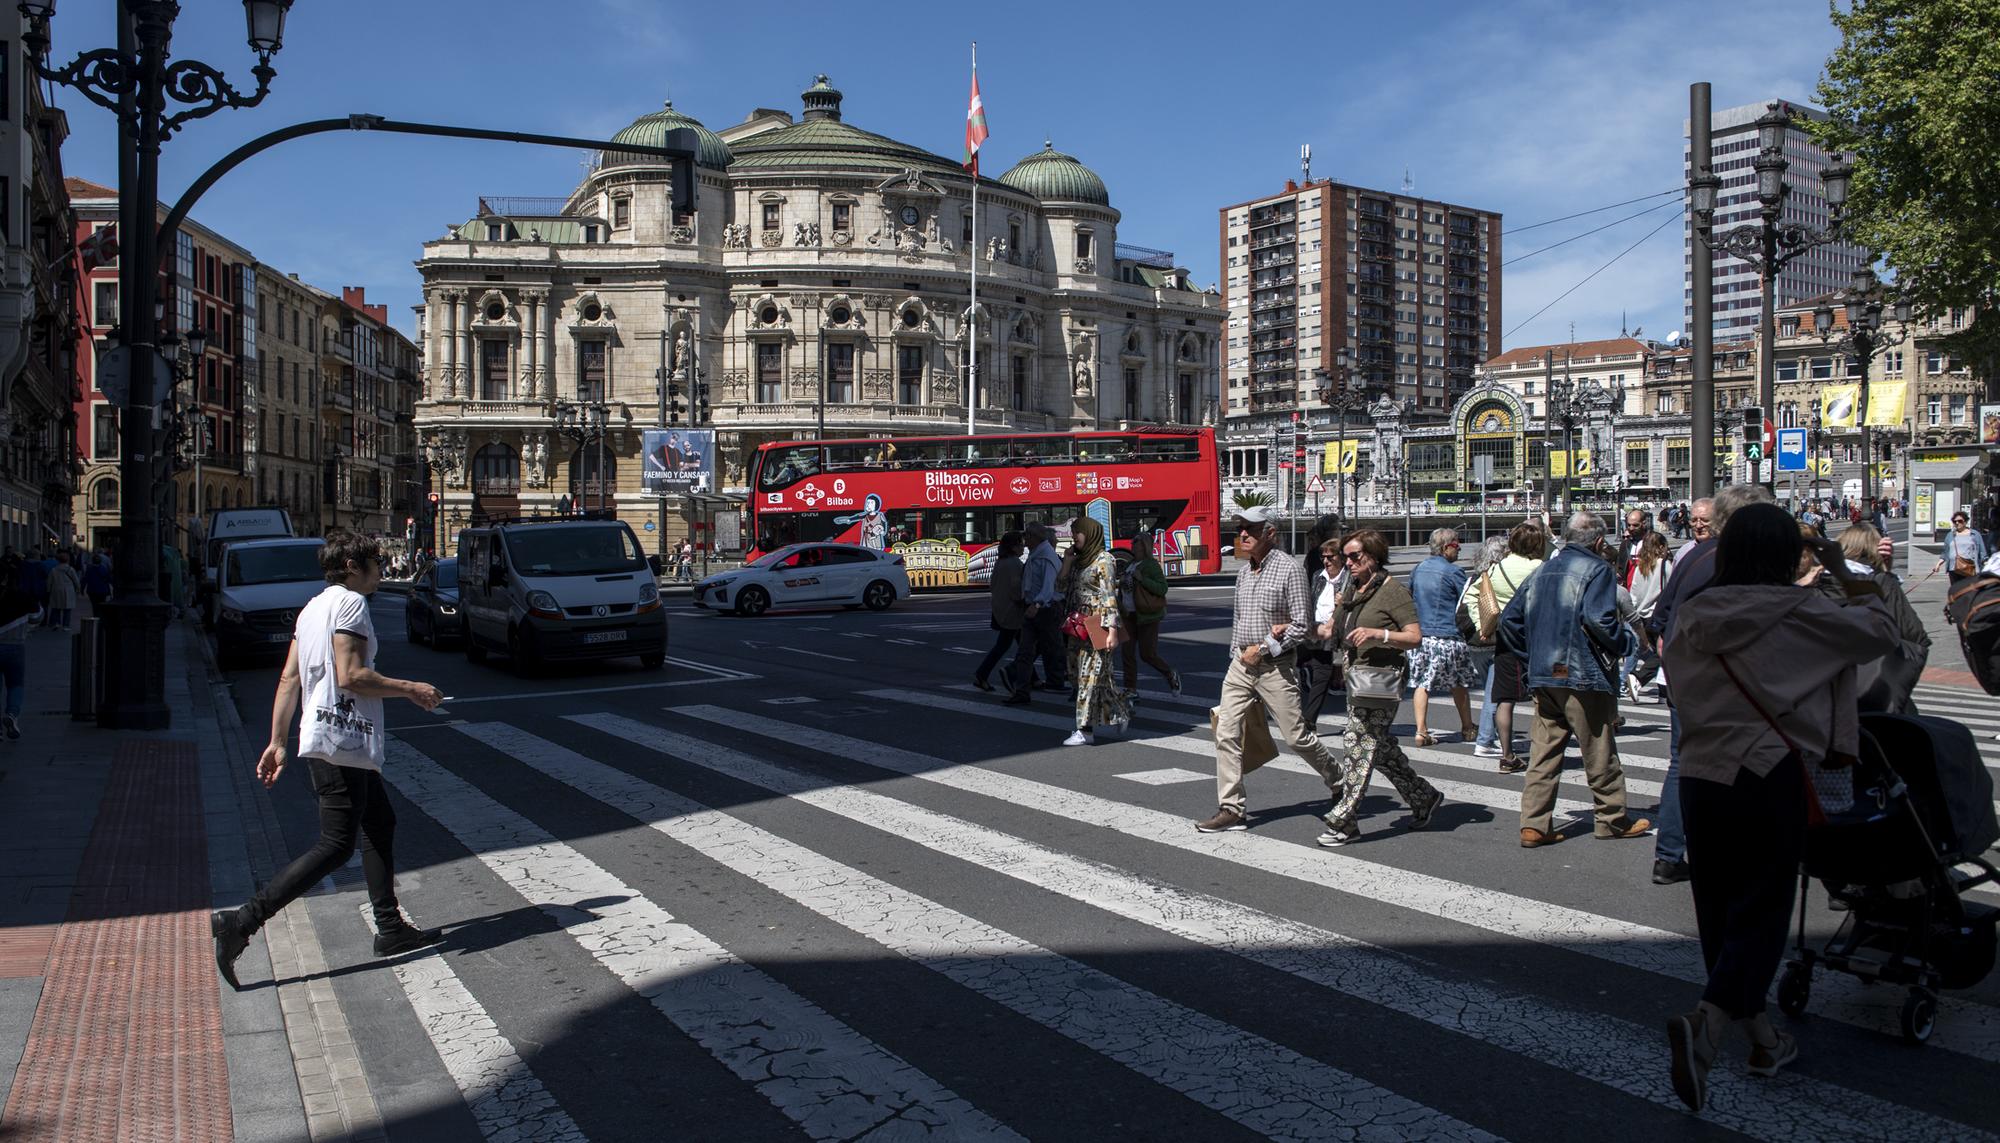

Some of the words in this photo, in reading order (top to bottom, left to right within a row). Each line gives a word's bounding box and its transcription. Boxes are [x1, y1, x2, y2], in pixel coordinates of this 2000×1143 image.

[1627, 441, 1648, 449] CAFE
[1927, 453, 1956, 461] ONCE
[643, 470, 673, 479] FAEMINO
[673, 471, 679, 479] Y
[925, 471, 969, 486] Bilbao
[836, 482, 843, 491] B
[926, 485, 954, 505] City
[958, 485, 994, 501] View
[826, 497, 854, 506] Bilbao
[316, 709, 374, 735] WAYNE
